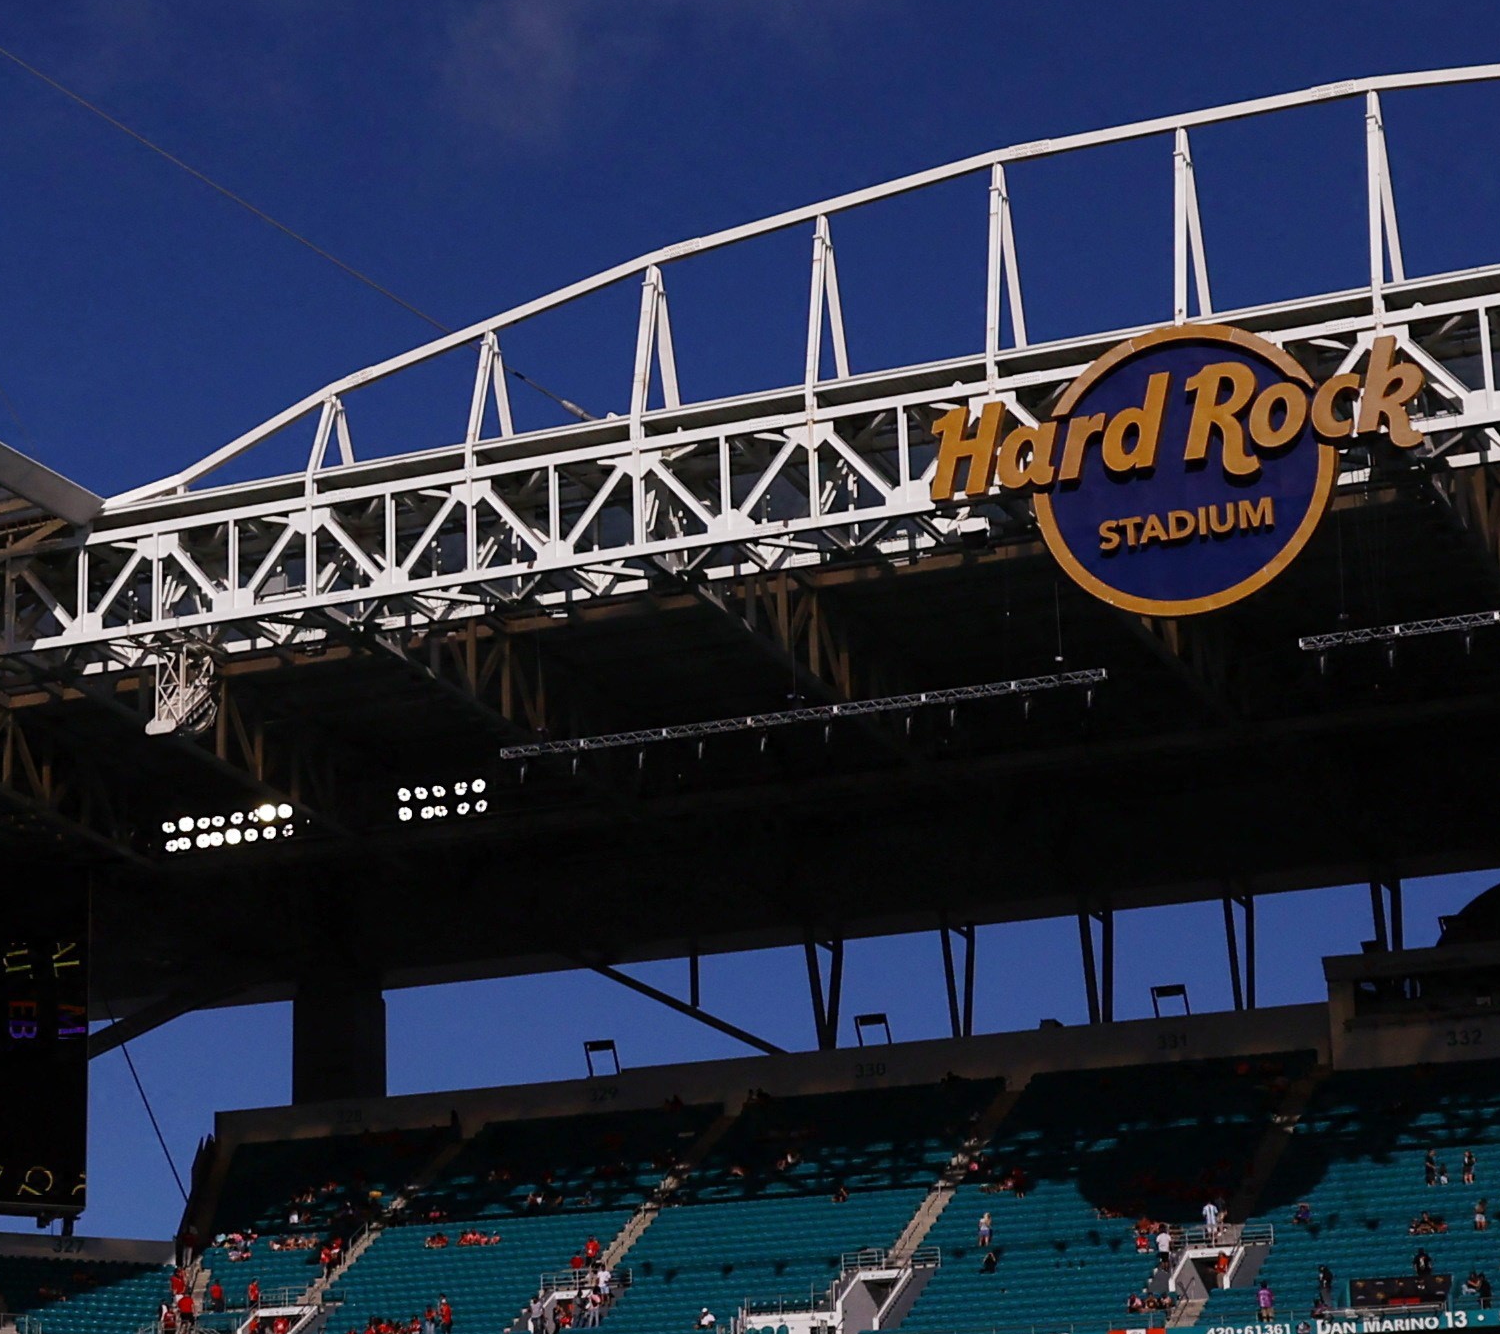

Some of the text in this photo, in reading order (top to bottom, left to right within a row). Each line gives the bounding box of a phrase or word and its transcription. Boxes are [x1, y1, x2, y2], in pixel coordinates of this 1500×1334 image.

[930, 336, 1425, 501] Hard Rock
[1099, 496, 1275, 553] STADIUM
[1447, 1028, 1482, 1047] 332
[52, 1237, 84, 1253] 327
[1444, 1311, 1469, 1330] 13
